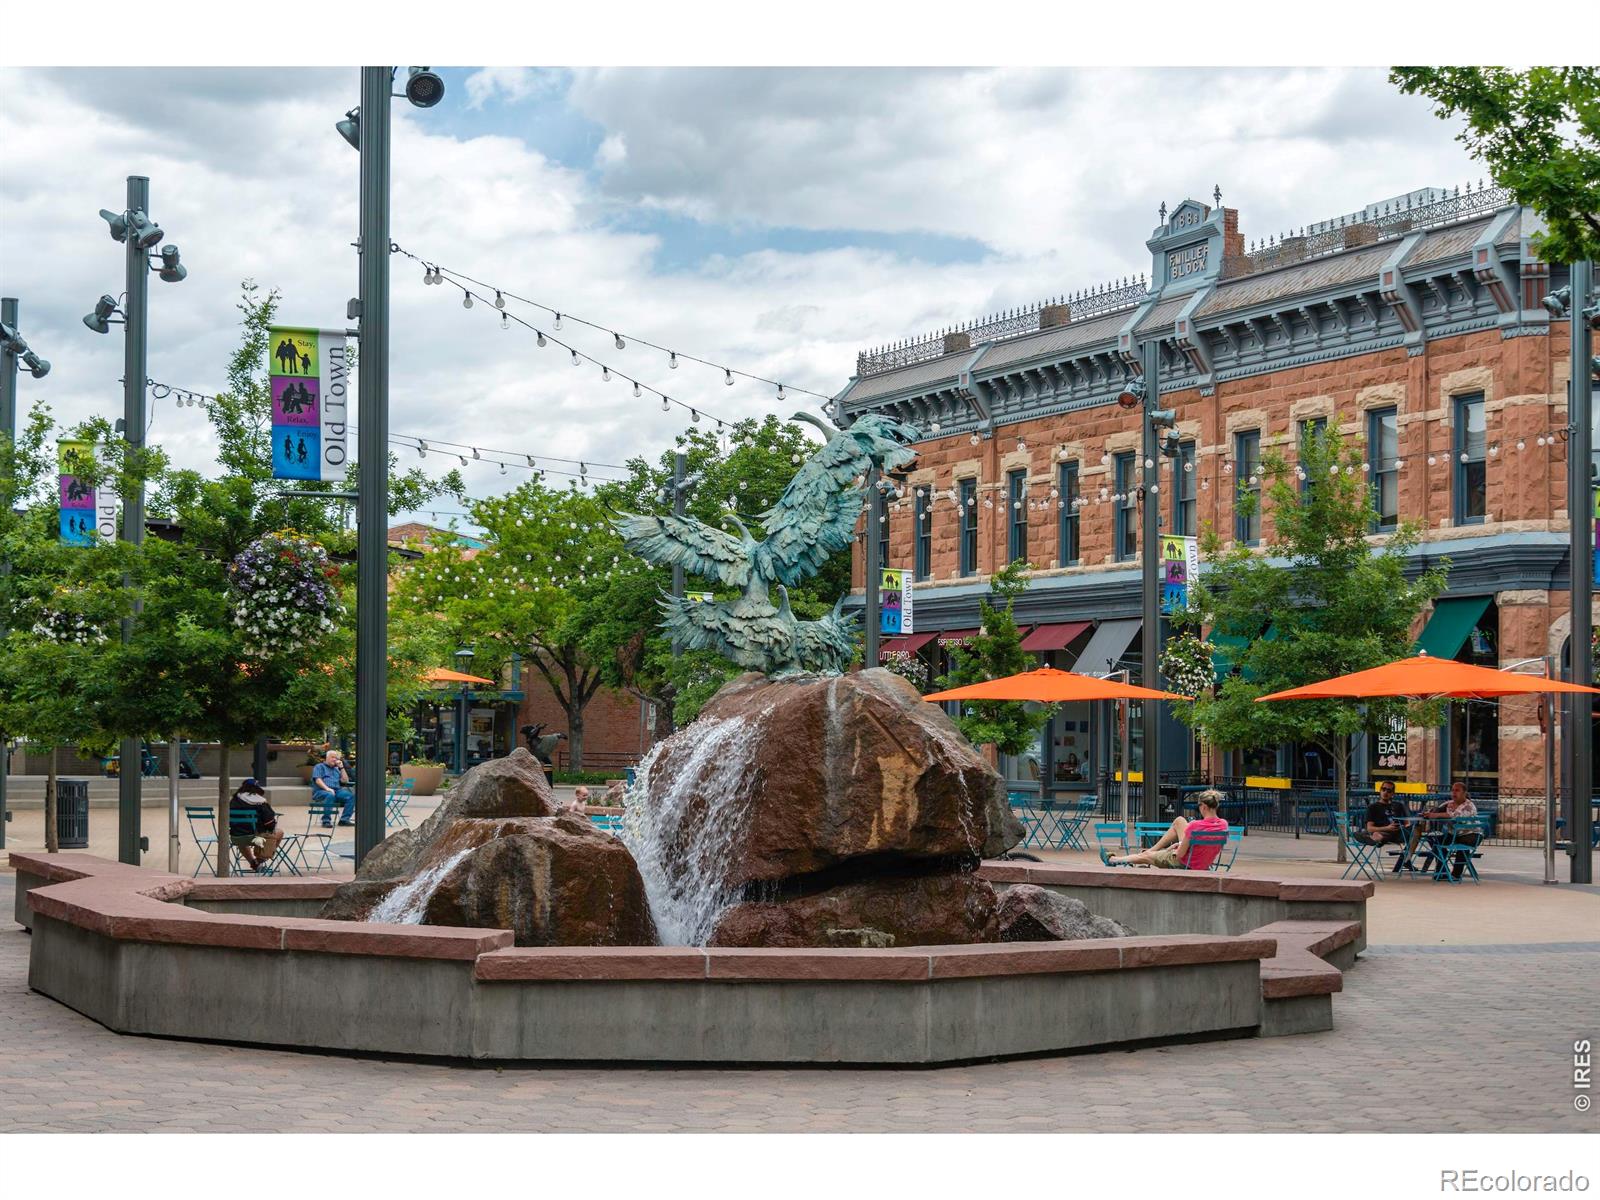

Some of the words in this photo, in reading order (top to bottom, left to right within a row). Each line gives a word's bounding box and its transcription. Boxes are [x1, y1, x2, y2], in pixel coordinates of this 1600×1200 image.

[1172, 258, 1206, 279] BLOCK
[325, 347, 345, 413] Town
[325, 421, 345, 466] Old
[99, 506, 115, 537] Old
[904, 577, 912, 604] Town
[904, 608, 912, 628] Old
[1378, 742, 1407, 754] BAR
